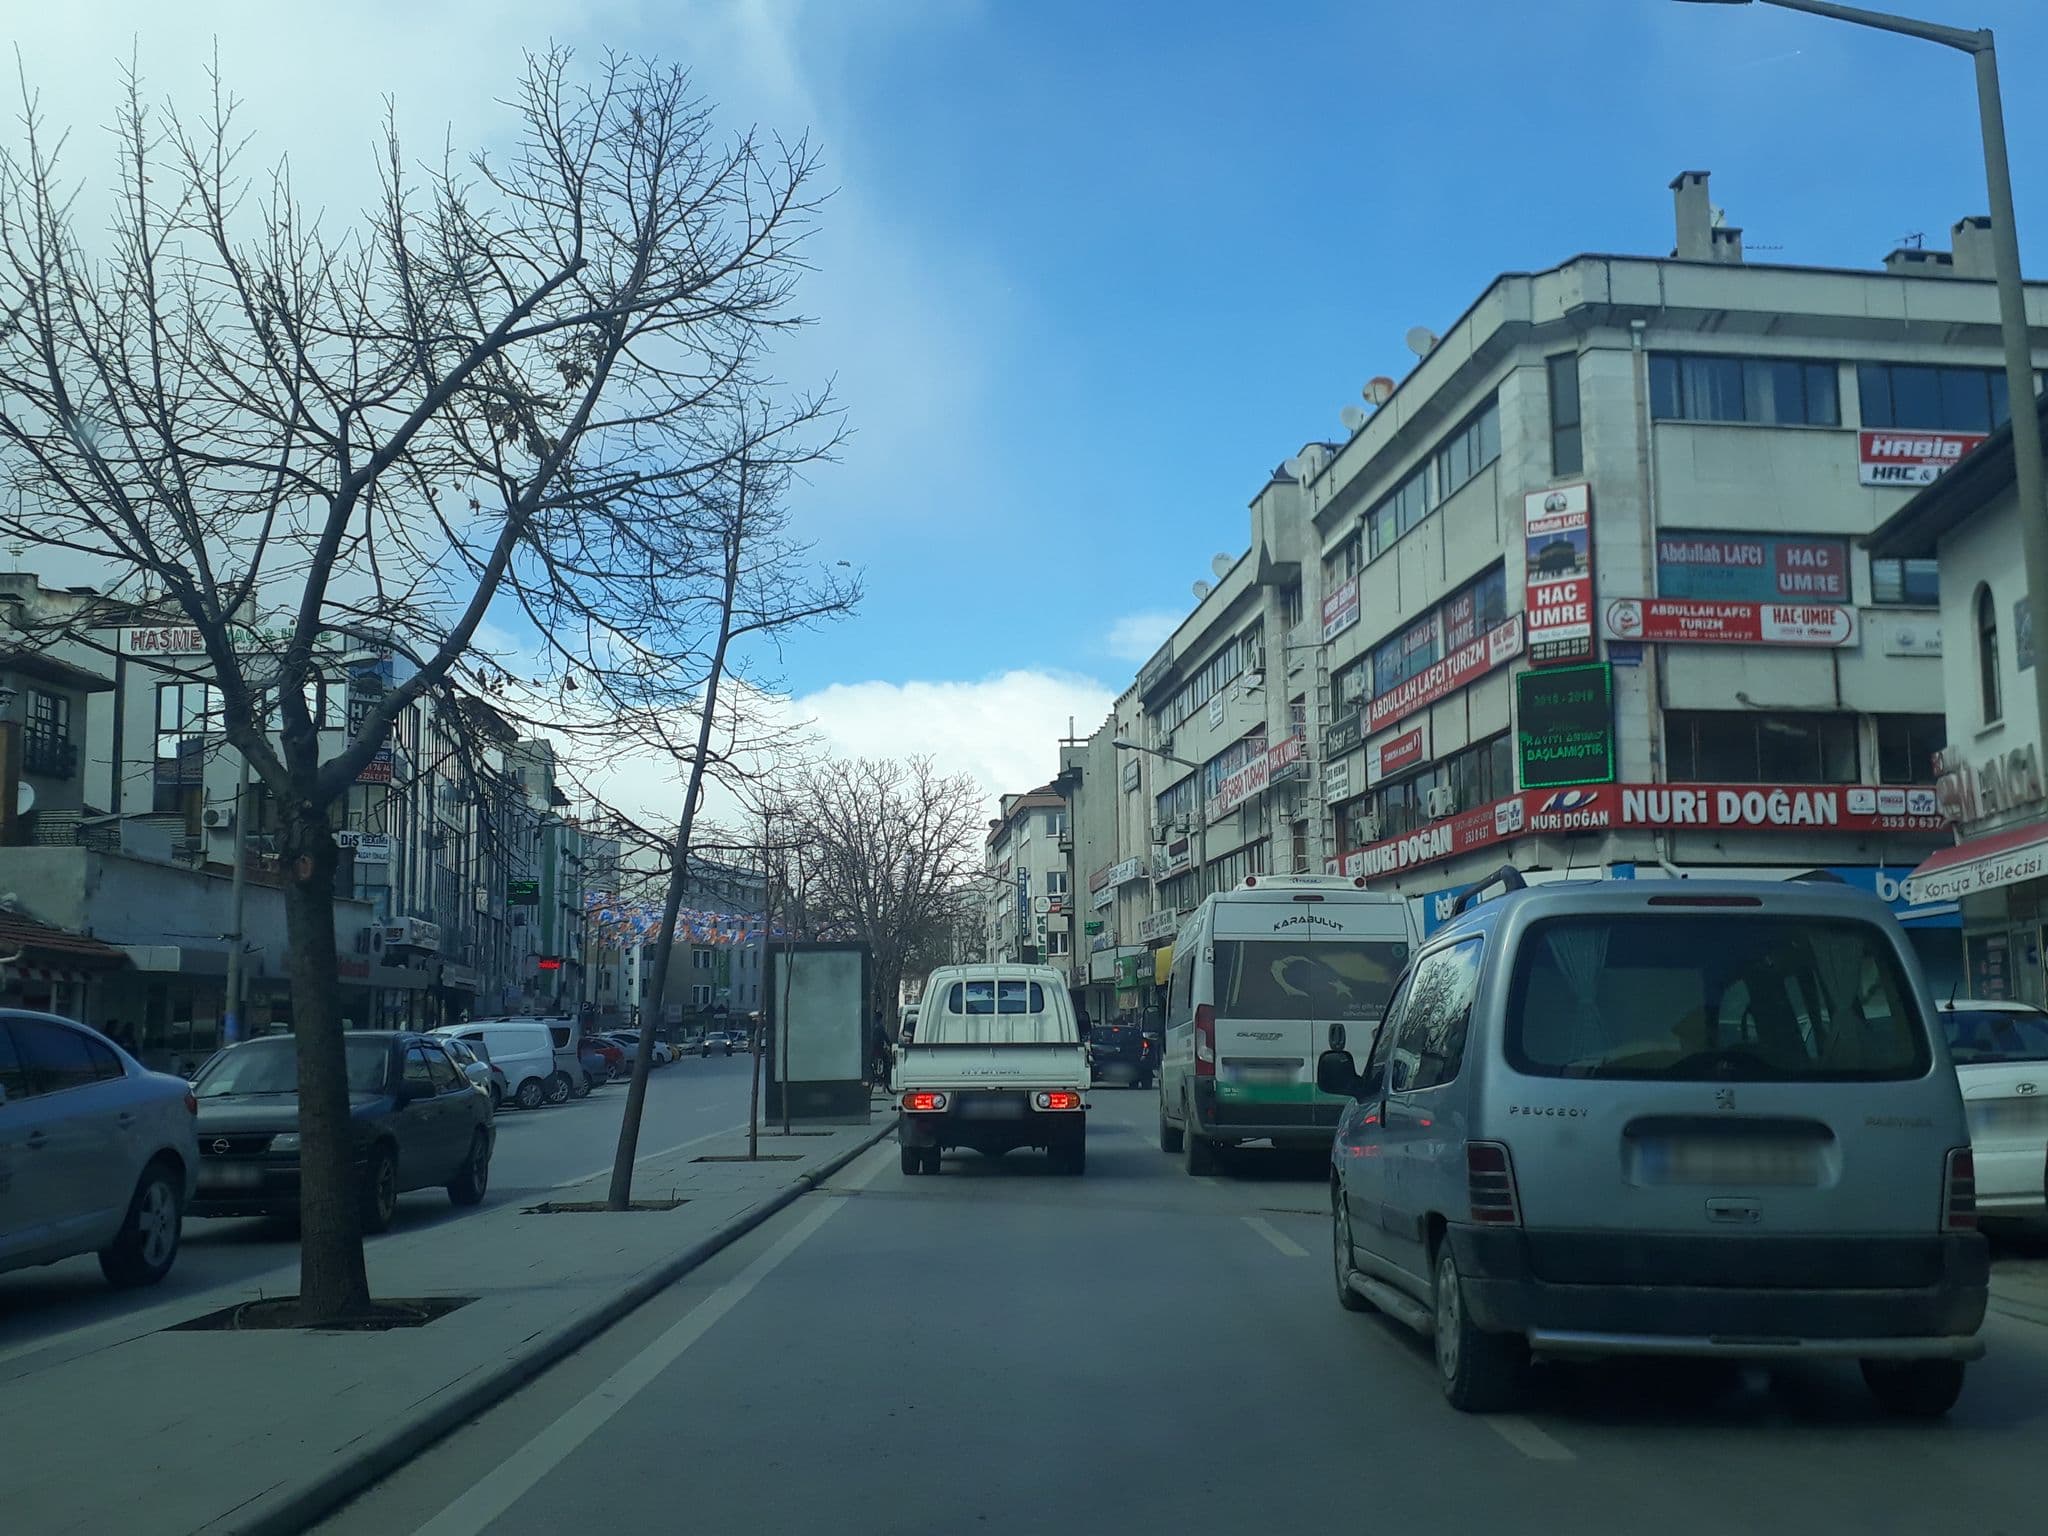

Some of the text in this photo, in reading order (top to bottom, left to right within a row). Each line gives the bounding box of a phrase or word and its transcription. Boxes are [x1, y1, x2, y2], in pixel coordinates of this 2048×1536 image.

[1660, 542, 1763, 565] Abdullah LAFCI
[1787, 549, 1828, 567] HAC
[1779, 572, 1839, 593] UMRE
[1537, 582, 1578, 607] HAC
[1529, 602, 1588, 628] UMRE
[1650, 605, 1752, 618] ABDULLAH LAFCI
[1679, 617, 1725, 630] TURİZM
[130, 629, 202, 651] HASME
[1372, 680, 1418, 721] ABDULLAH
[1417, 666, 1446, 696] LAFCI
[1446, 639, 1485, 678] TURİZM
[1621, 787, 1838, 826] NURİ DOĞAN
[1530, 809, 1609, 831] NURİ DOĞAN
[1881, 816, 1906, 828] 353
[1363, 824, 1453, 876] NURİ DOĞAN
[1924, 855, 2042, 899] Konya Kellecisi
[1273, 915, 1344, 932] KARABULUT
[1509, 1105, 1588, 1117] PEUGEOT
